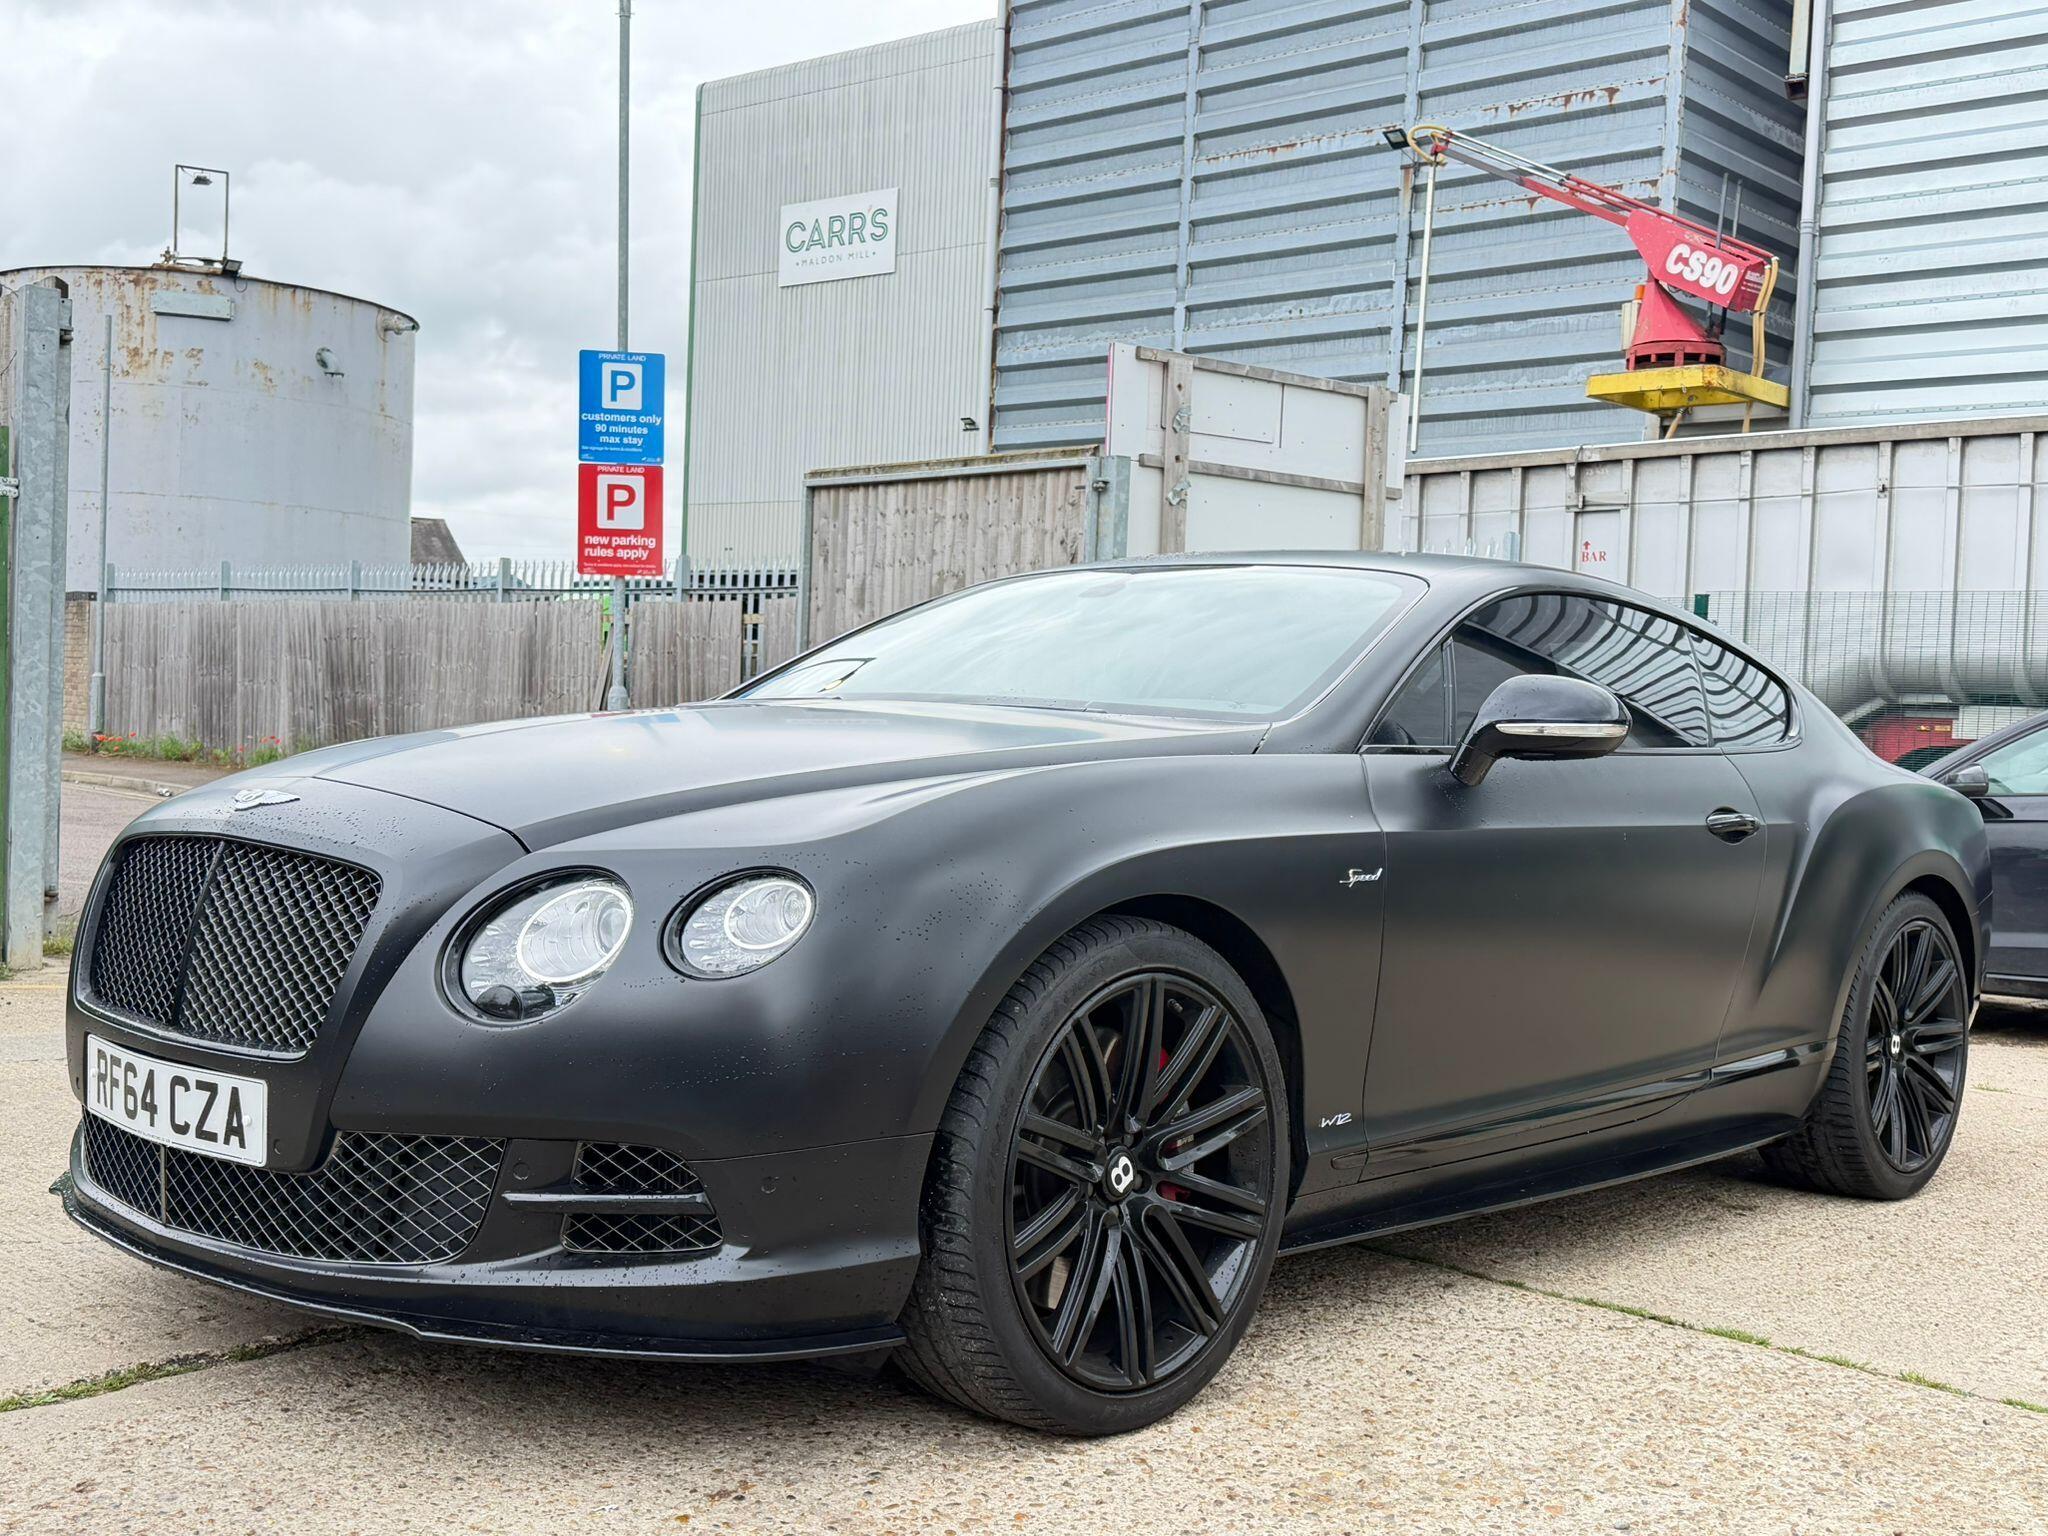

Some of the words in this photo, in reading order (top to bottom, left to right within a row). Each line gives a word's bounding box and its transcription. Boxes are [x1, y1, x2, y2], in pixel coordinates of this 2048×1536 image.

[786, 204, 888, 253] CARR'S
[801, 254, 842, 267] MALDON
[848, 250, 870, 261] MILL
[1666, 243, 1738, 295] CS90
[610, 370, 636, 402] P
[581, 412, 637, 423] customers
[639, 414, 662, 426] only
[595, 424, 607, 433] 90
[609, 425, 649, 435] minutes
[599, 436, 621, 444] max
[622, 436, 644, 446] stay
[606, 483, 637, 521] P
[584, 536, 610, 545] new
[612, 535, 656, 549] parking
[584, 546, 614, 557] rules
[617, 548, 650, 560] apply
[1582, 550, 1607, 562] BAR
[1339, 867, 1383, 888] Speed
[97, 1047, 158, 1128] RF64
[170, 1075, 247, 1150] CZA
